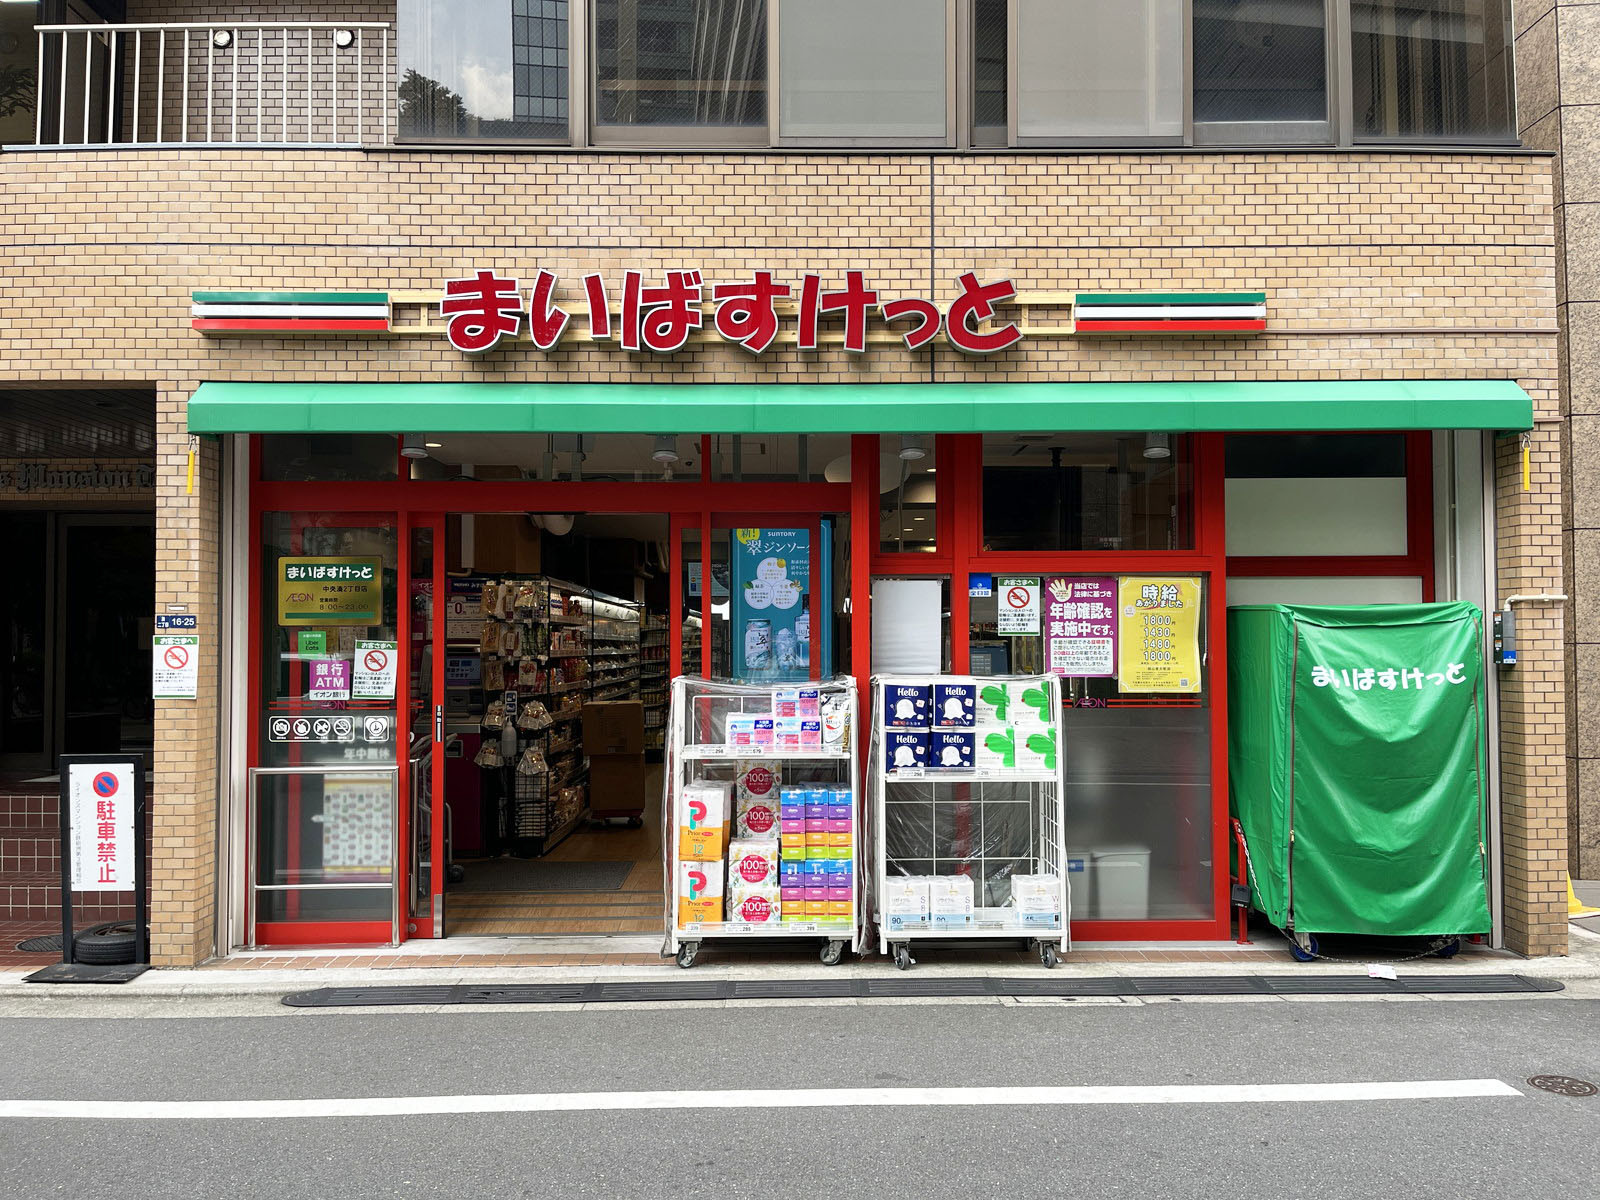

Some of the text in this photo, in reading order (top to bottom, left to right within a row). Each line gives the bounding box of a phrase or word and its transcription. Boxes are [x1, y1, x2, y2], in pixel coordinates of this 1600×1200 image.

[439, 268, 1024, 354] まいばすけっと
[287, 566, 373, 579] まいばすけっと
[1074, 590, 1113, 598] 法律に基づき
[1141, 584, 1179, 601] 時給
[1135, 599, 1184, 608] あがりました
[1049, 602, 1113, 620] 年齢確認を
[171, 617, 194, 626] 16-25
[1049, 620, 1114, 637] 実施中です。
[315, 663, 343, 676] 銀行
[315, 677, 344, 687] ATM
[1311, 663, 1467, 691] まいばすけっと
[897, 687, 919, 697] Hello
[945, 686, 967, 696] Hello
[896, 734, 918, 744] Hello
[942, 734, 965, 744] Hello
[96, 800, 117, 883] 駐車禁止
[693, 844, 705, 854] 12
